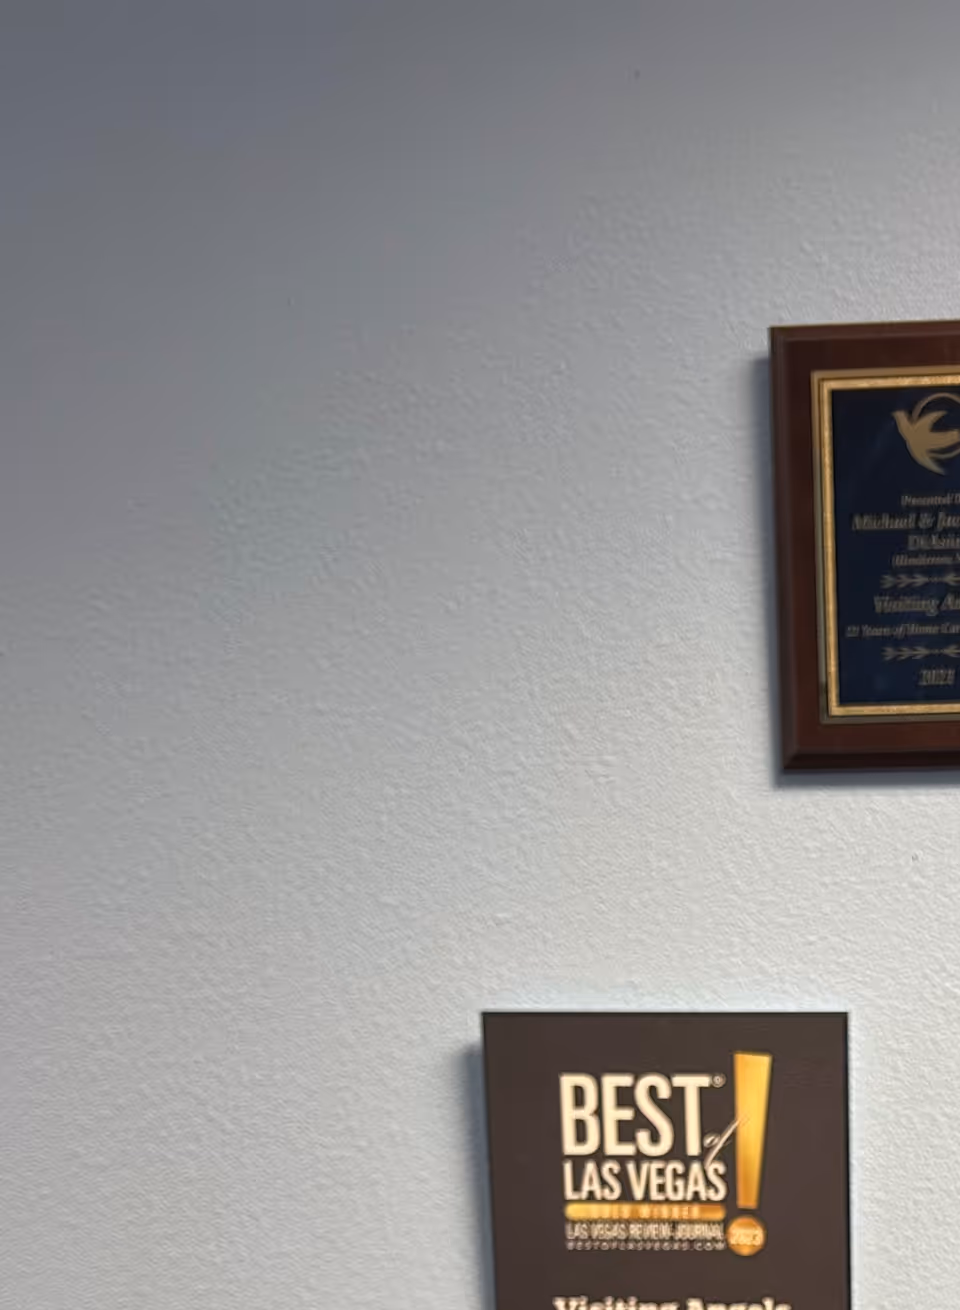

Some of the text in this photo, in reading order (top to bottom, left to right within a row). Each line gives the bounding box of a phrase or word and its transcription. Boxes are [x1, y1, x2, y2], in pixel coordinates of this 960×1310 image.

[852, 513, 915, 530] Michael
[874, 595, 938, 616] Visiting
[559, 1073, 712, 1157] BEST
[563, 1160, 727, 1201] LAS VEGAS
[566, 1223, 588, 1240] LAS
[590, 1223, 627, 1240] VEGAS
